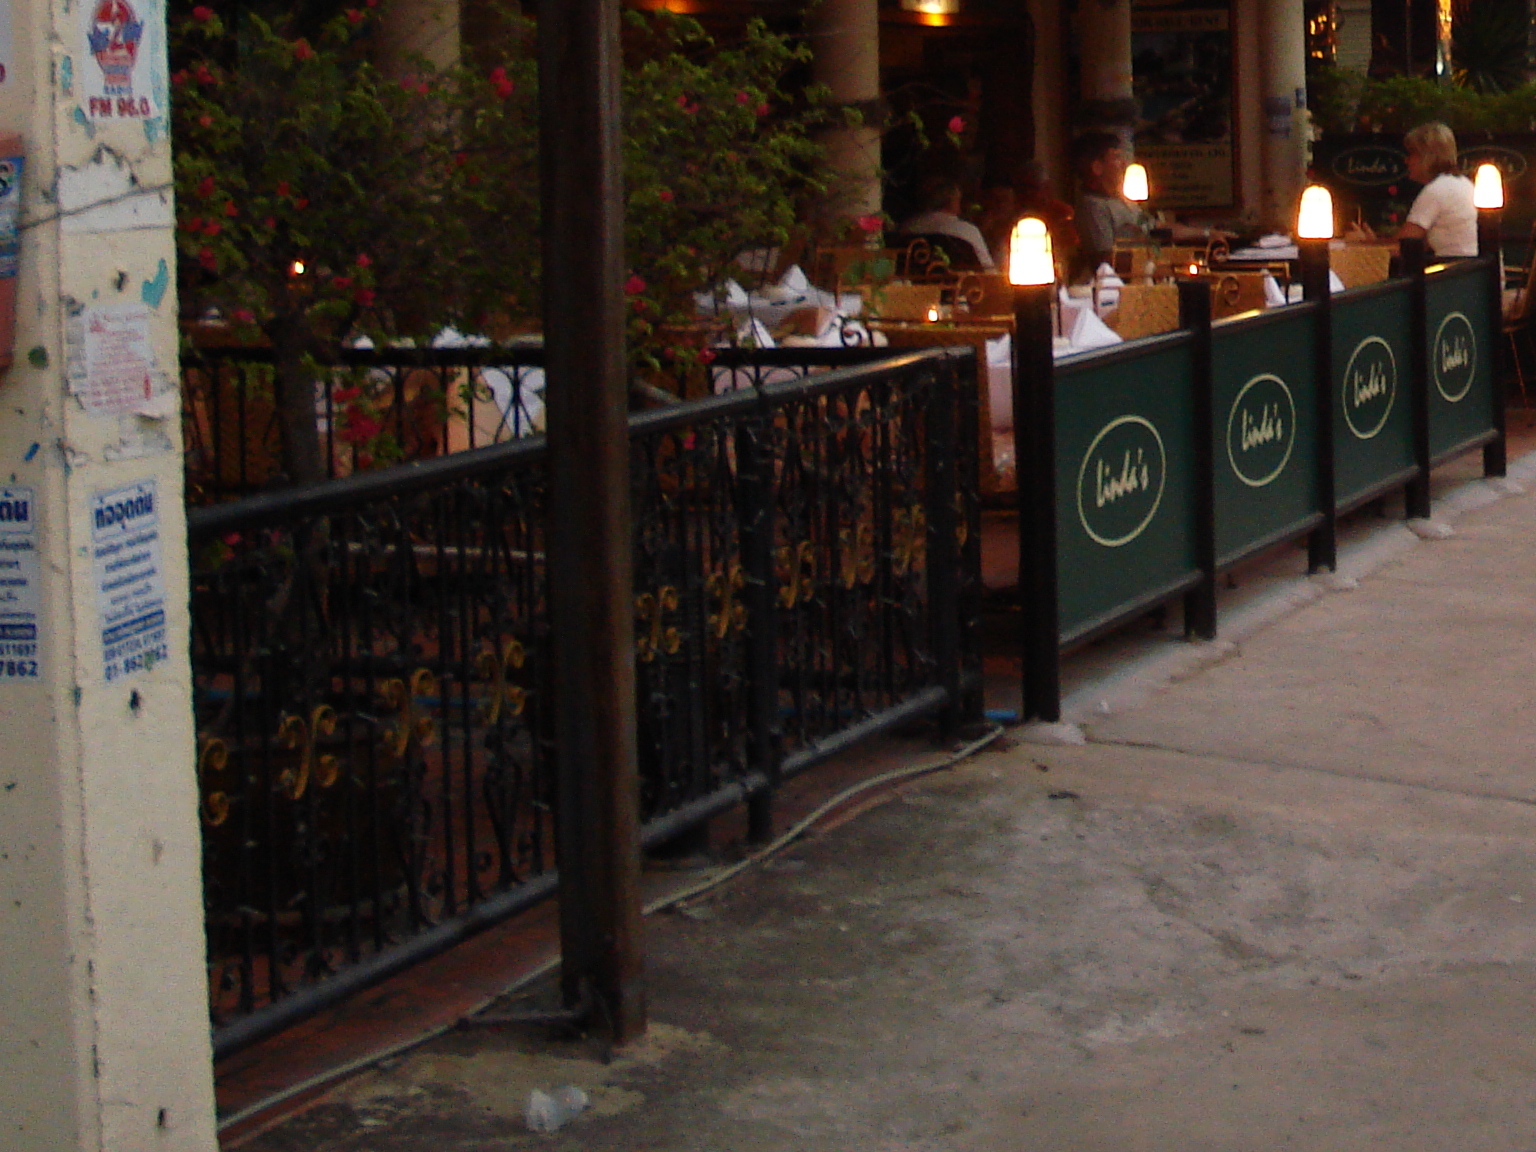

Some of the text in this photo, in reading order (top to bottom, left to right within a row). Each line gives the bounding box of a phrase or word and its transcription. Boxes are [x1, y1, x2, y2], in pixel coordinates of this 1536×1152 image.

[89, 97, 111, 117] FM
[1354, 361, 1386, 408] Linda's
[1242, 402, 1282, 452] Linda's
[1096, 446, 1149, 508] Linda's
